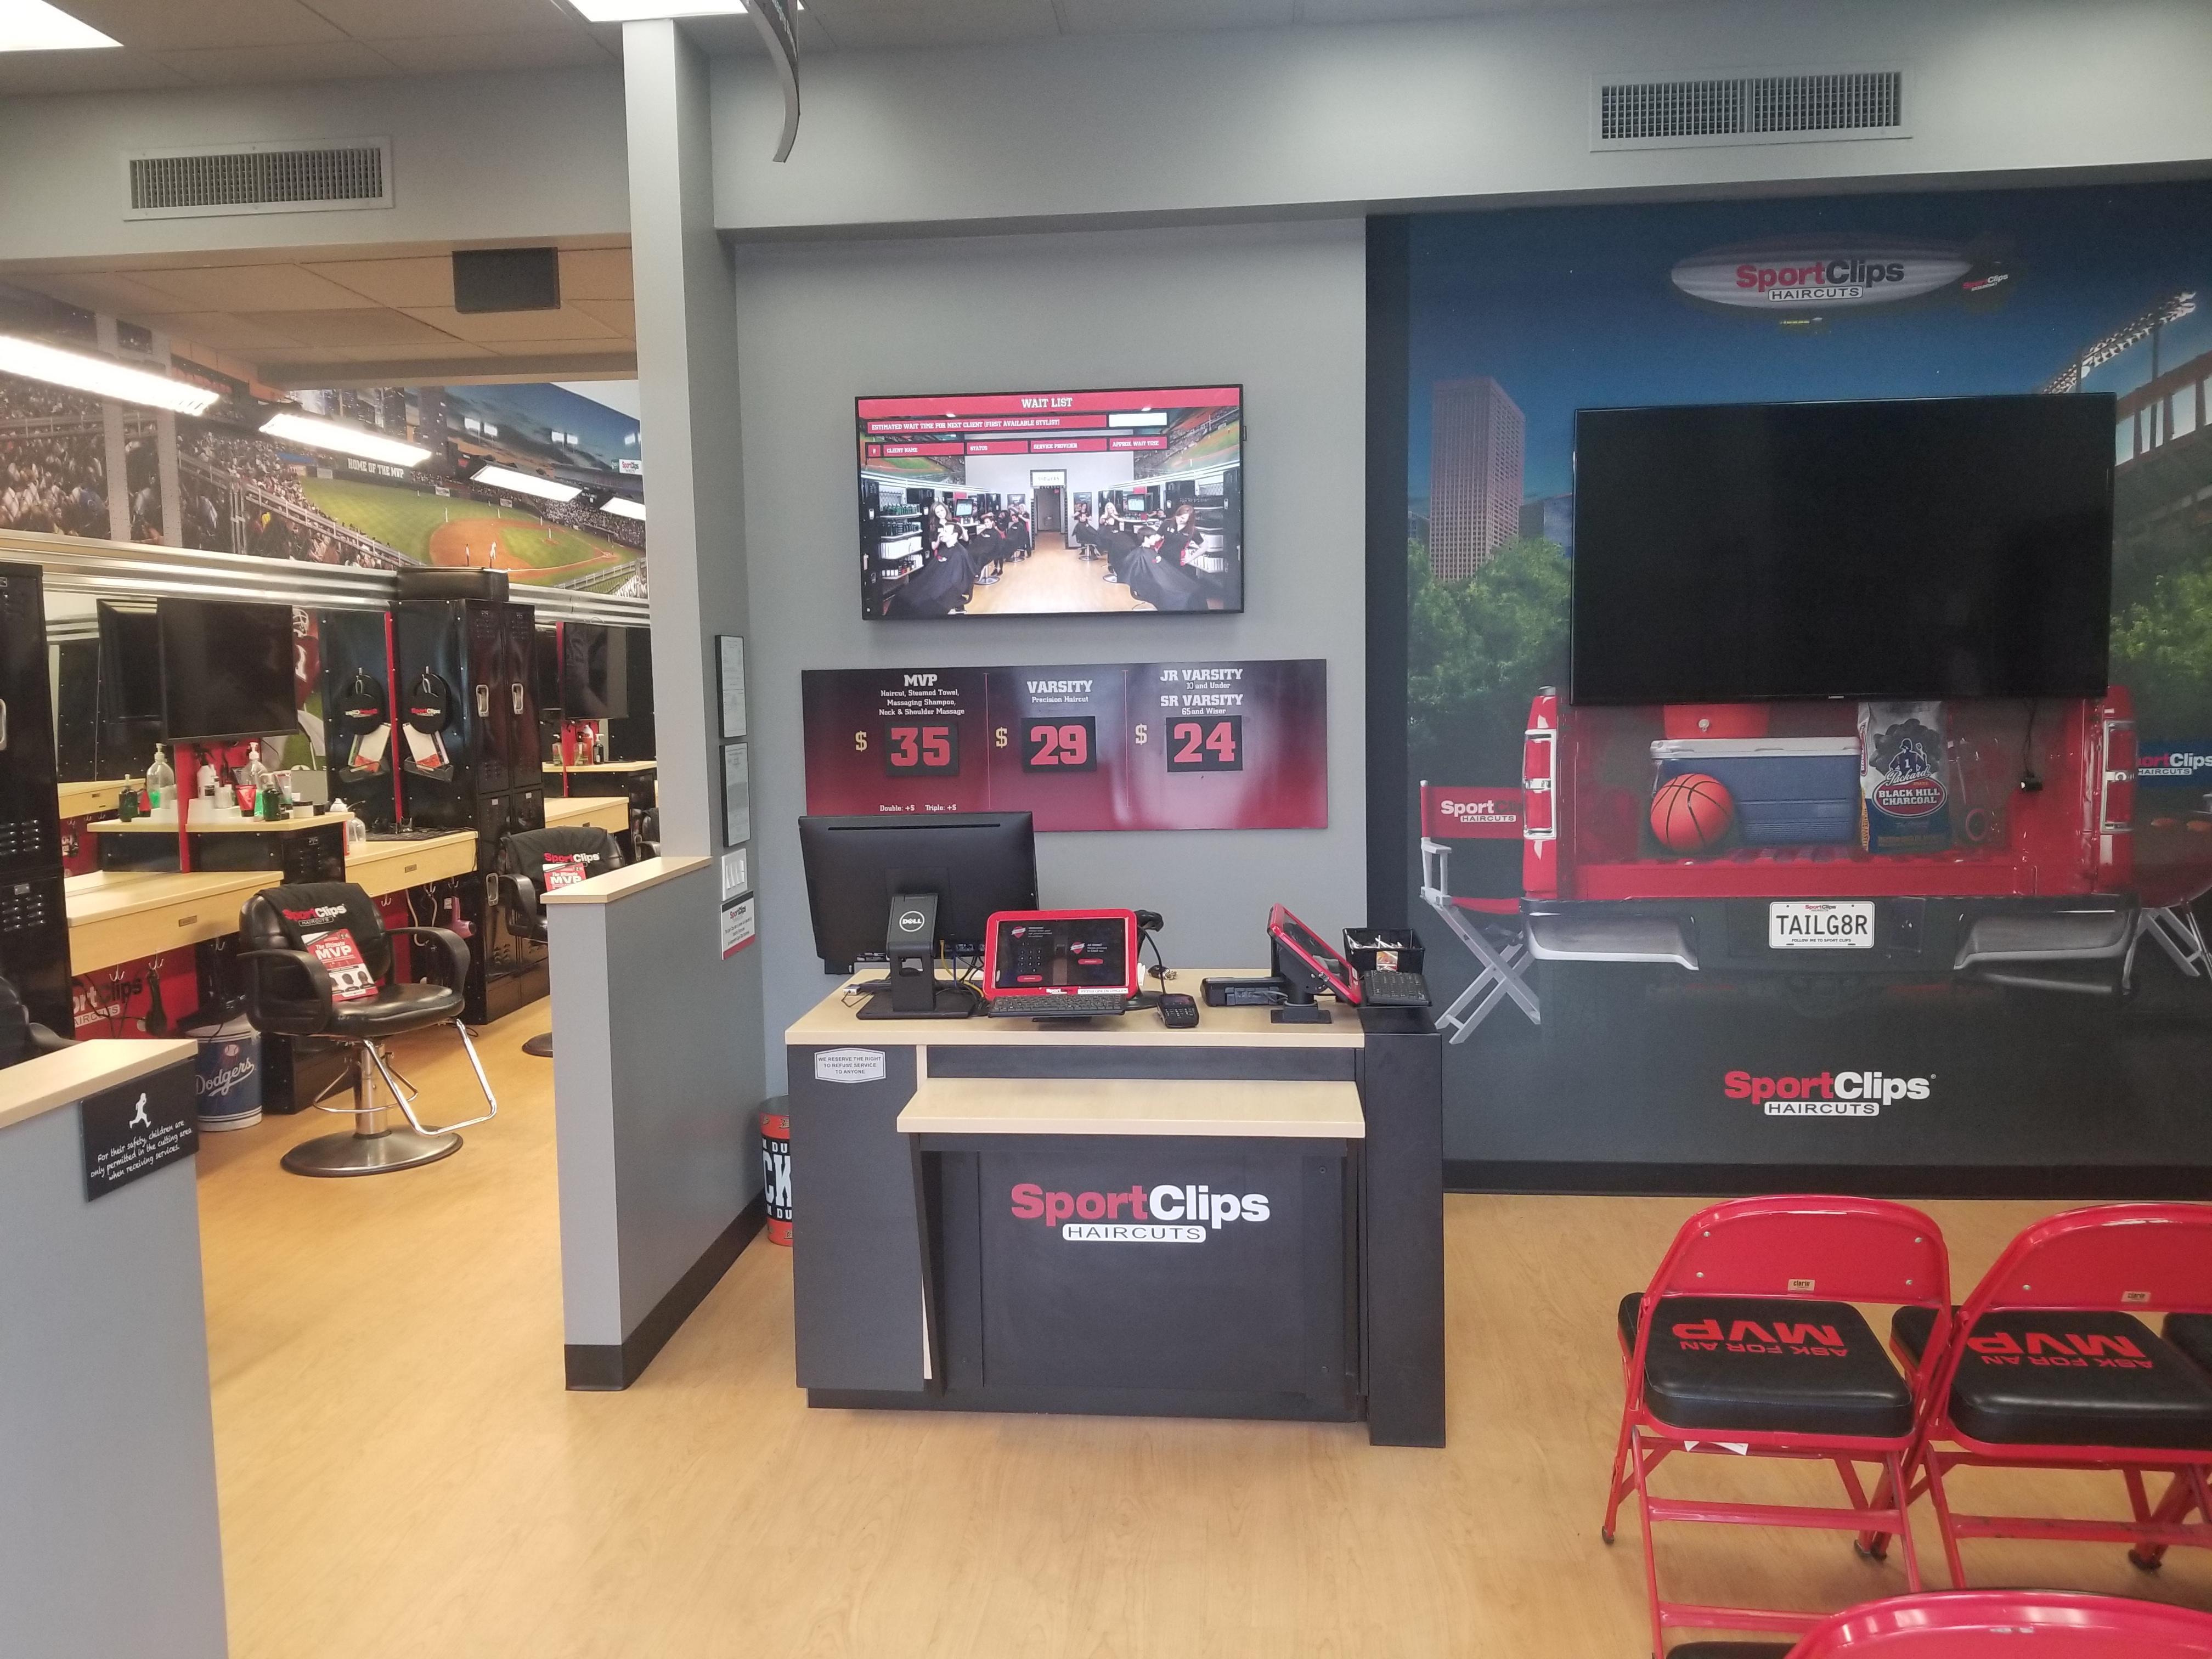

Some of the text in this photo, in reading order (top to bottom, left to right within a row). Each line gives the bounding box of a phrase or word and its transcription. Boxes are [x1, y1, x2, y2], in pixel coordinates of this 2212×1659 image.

[1771, 287, 1860, 300] HAIRCUTS
[1022, 398, 1073, 408] WAIT LIST
[347, 458, 404, 478] HOME OF THE MVP
[904, 674, 938, 686] MVP
[1160, 668, 1243, 681] JR VARSITY
[938, 689, 960, 697] Towel,
[1026, 680, 1093, 694] VARSITY
[1064, 695, 1089, 703] Haircut
[1160, 693, 1244, 707] SR VARSITY
[855, 726, 950, 766] $ 35
[995, 724, 1087, 765] $ 29
[1135, 721, 1236, 763] $ 24
[1886, 764, 1931, 786] Packard
[1878, 788, 1940, 798] BLACK HILL
[1882, 795, 1937, 805] CHARCOAL
[925, 804, 945, 812] Triple:
[550, 876, 582, 884] MVP
[1776, 914, 1868, 935] TAILG8R
[315, 945, 352, 960] MVP
[196, 1057, 255, 1097] Dodgers
[1768, 1104, 1875, 1114] HAIRCUTS
[98, 1120, 184, 1163] For their safety, children are
[91, 1166, 105, 1178] only
[106, 1150, 137, 1175] permitted
[146, 1143, 156, 1153] the
[157, 1134, 178, 1147] cutting
[179, 1127, 192, 1138] area
[109, 1169, 125, 1181] when
[126, 1156, 154, 1172] receiving
[1068, 1227, 1201, 1240] HAIRCUTS
[1672, 1319, 1844, 1346] MVP
[1680, 1341, 1848, 1357] ASK FOR AN
[1967, 1332, 2146, 1357] MVP
[1981, 1355, 2154, 1368] ASK FOR AN
